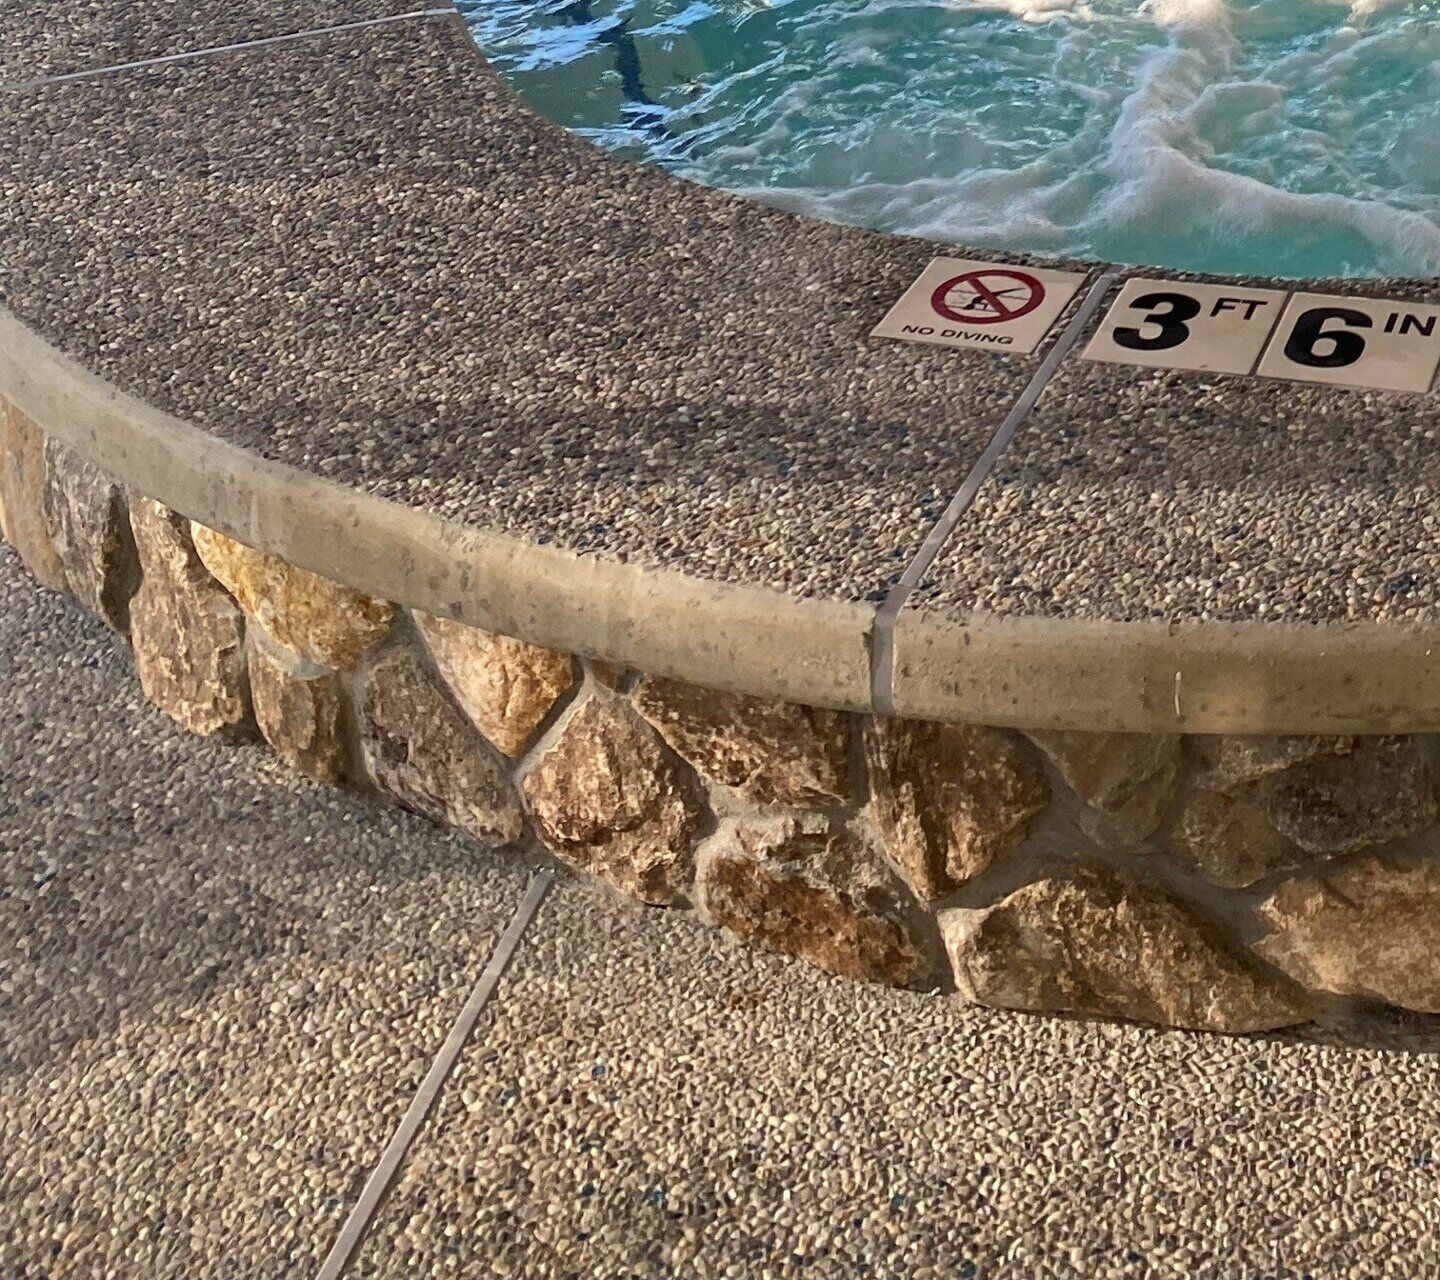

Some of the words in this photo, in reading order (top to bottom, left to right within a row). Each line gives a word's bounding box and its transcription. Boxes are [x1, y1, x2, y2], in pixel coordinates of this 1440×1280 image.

[901, 325, 935, 335] NO
[940, 329, 1015, 345] DIVING
[1112, 292, 1202, 351] 3
[1209, 297, 1269, 321] FT
[1283, 307, 1374, 368] 6
[1383, 312, 1438, 337] IN
